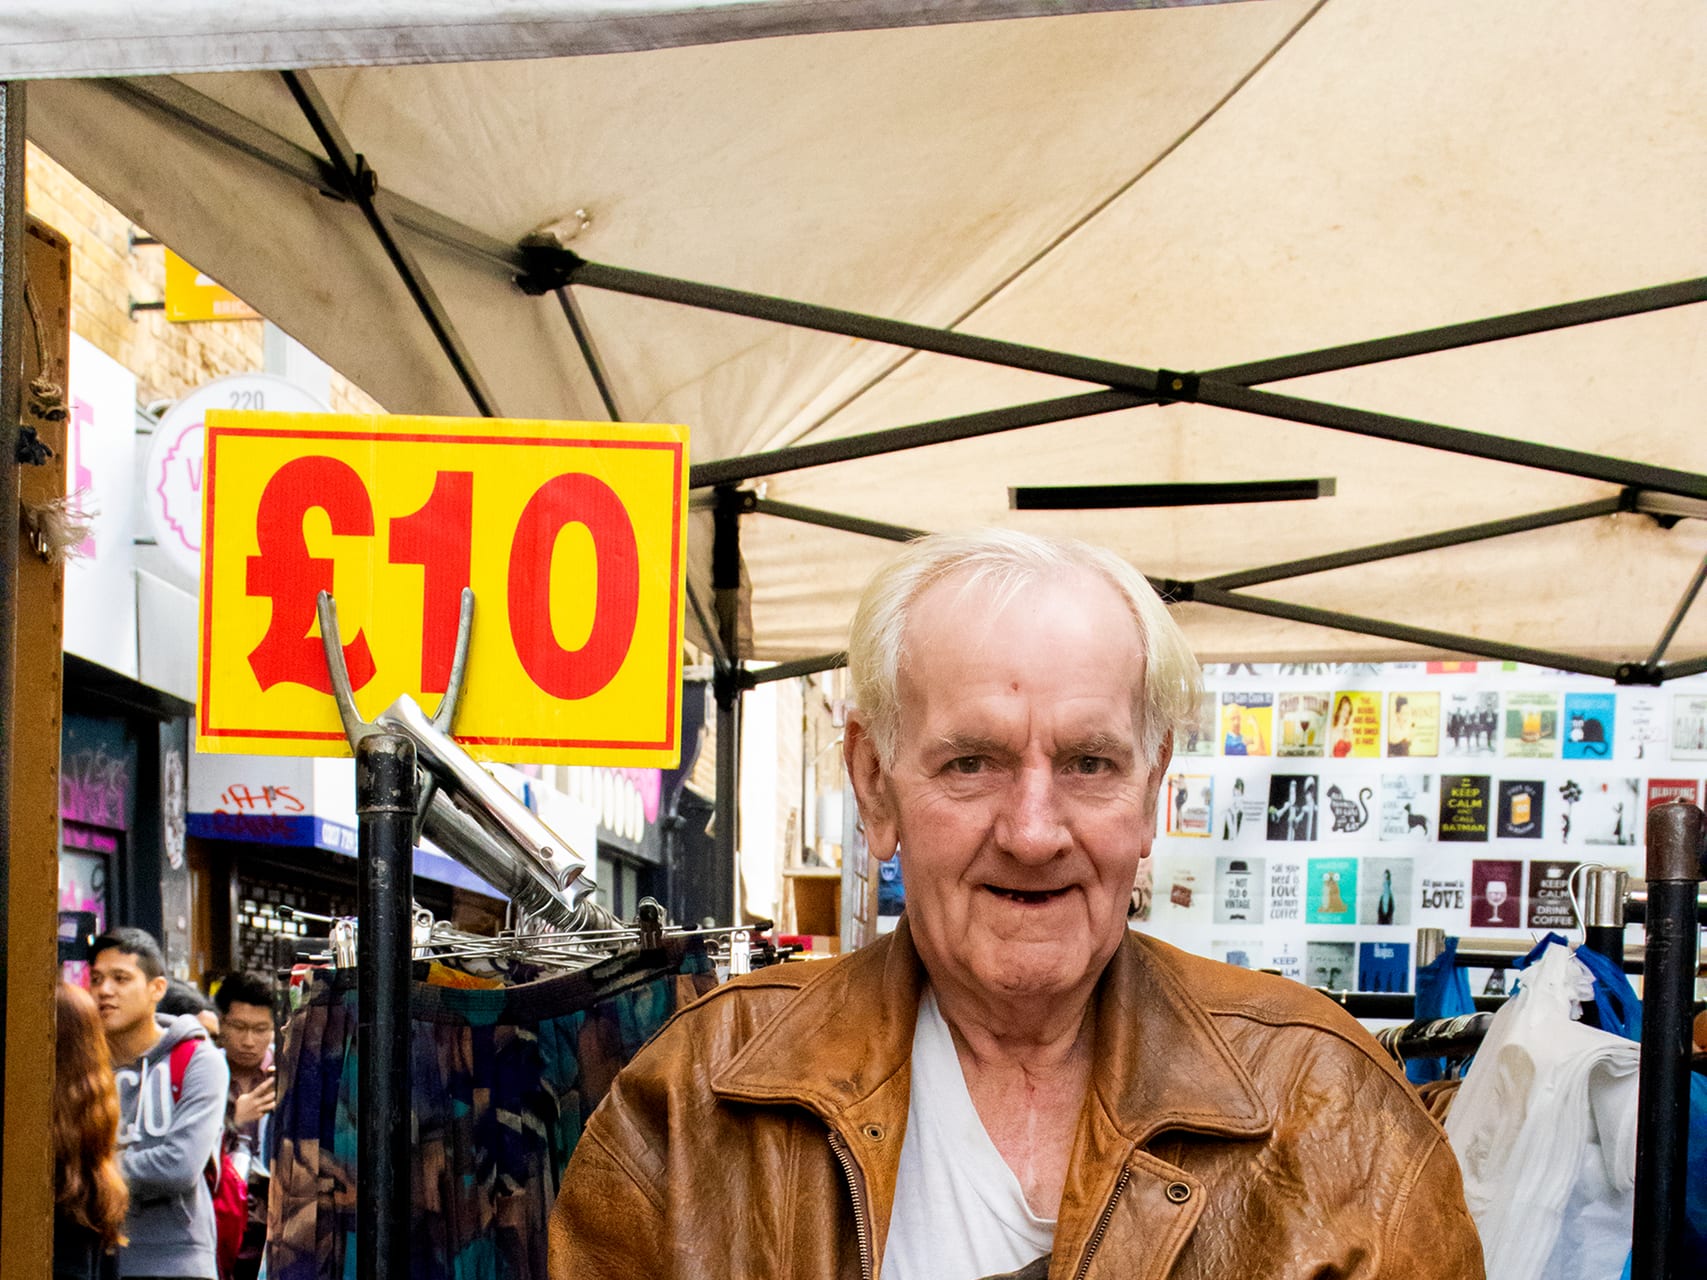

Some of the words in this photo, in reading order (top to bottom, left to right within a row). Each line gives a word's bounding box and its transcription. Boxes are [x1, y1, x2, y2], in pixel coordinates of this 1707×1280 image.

[229, 391, 264, 410] 220
[246, 455, 640, 701] £10
[1451, 788, 1480, 797] KEEP
[1447, 799, 1483, 808] CALM
[1442, 824, 1486, 832] BATMAN
[1422, 889, 1465, 909] LOVE
[1536, 905, 1570, 915] DRINK
[1531, 915, 1574, 926] COFFEE
[1273, 957, 1298, 965] KEEP
